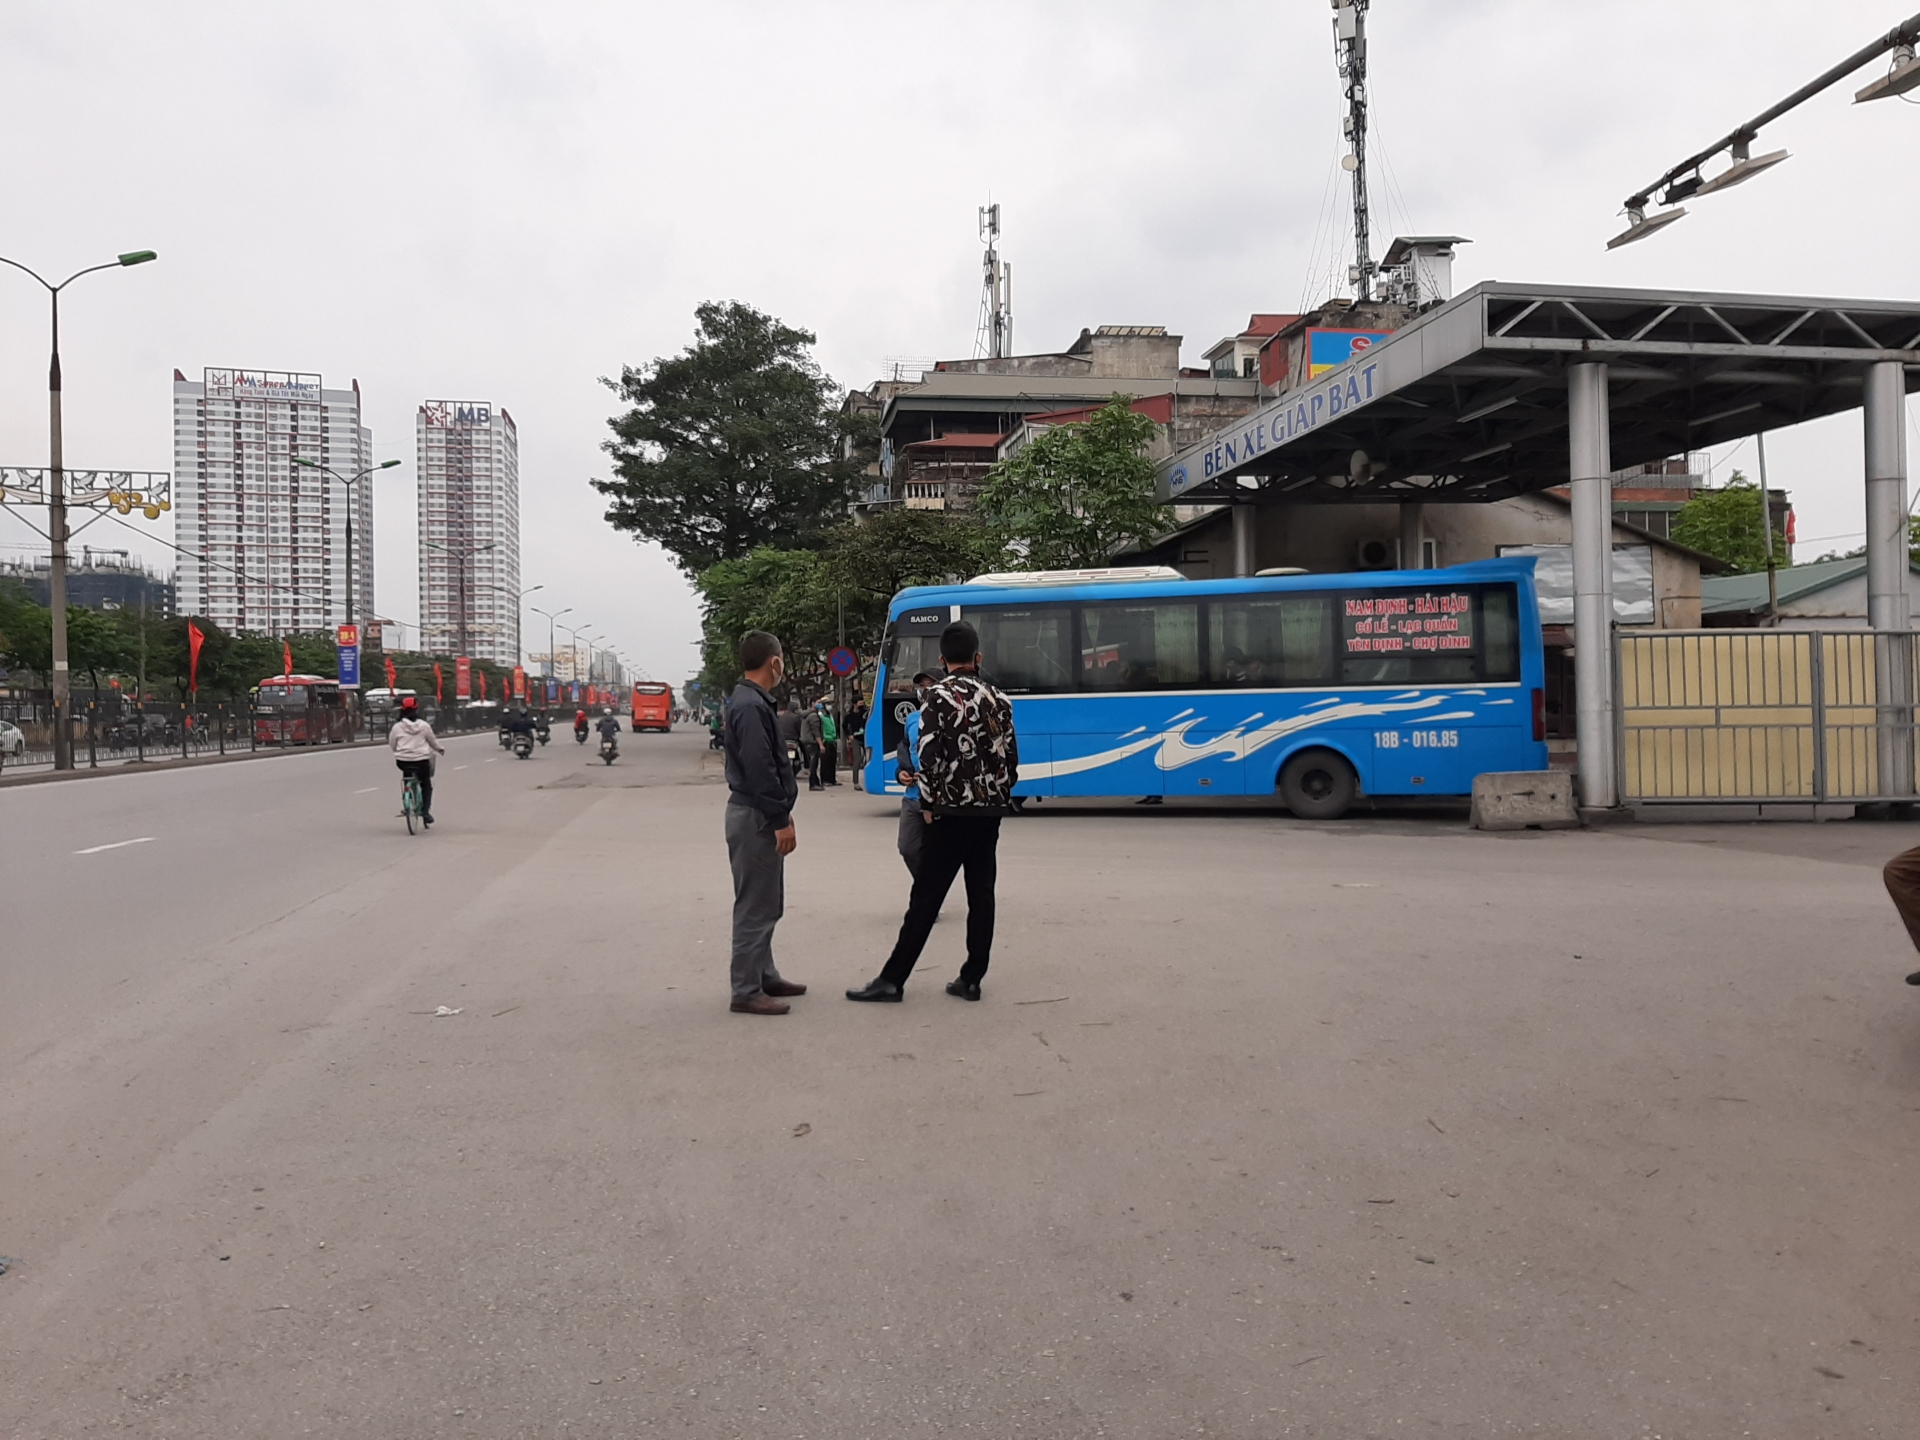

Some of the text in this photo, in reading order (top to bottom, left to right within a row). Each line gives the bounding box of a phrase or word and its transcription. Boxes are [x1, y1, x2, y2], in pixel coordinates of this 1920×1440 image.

[456, 407, 490, 423] MB
[1204, 361, 1377, 478] BẾN XE GIÁP BÁT
[1345, 599, 1374, 616] NAM
[1415, 592, 1439, 614] HẢI
[910, 615, 940, 623] SAMCO
[1398, 619, 1422, 635] LẠC
[1346, 636, 1371, 652] YÊN
[1412, 635, 1438, 652] CHỢ
[1374, 731, 1399, 748] 18B
[1412, 730, 1459, 748] 016.85
